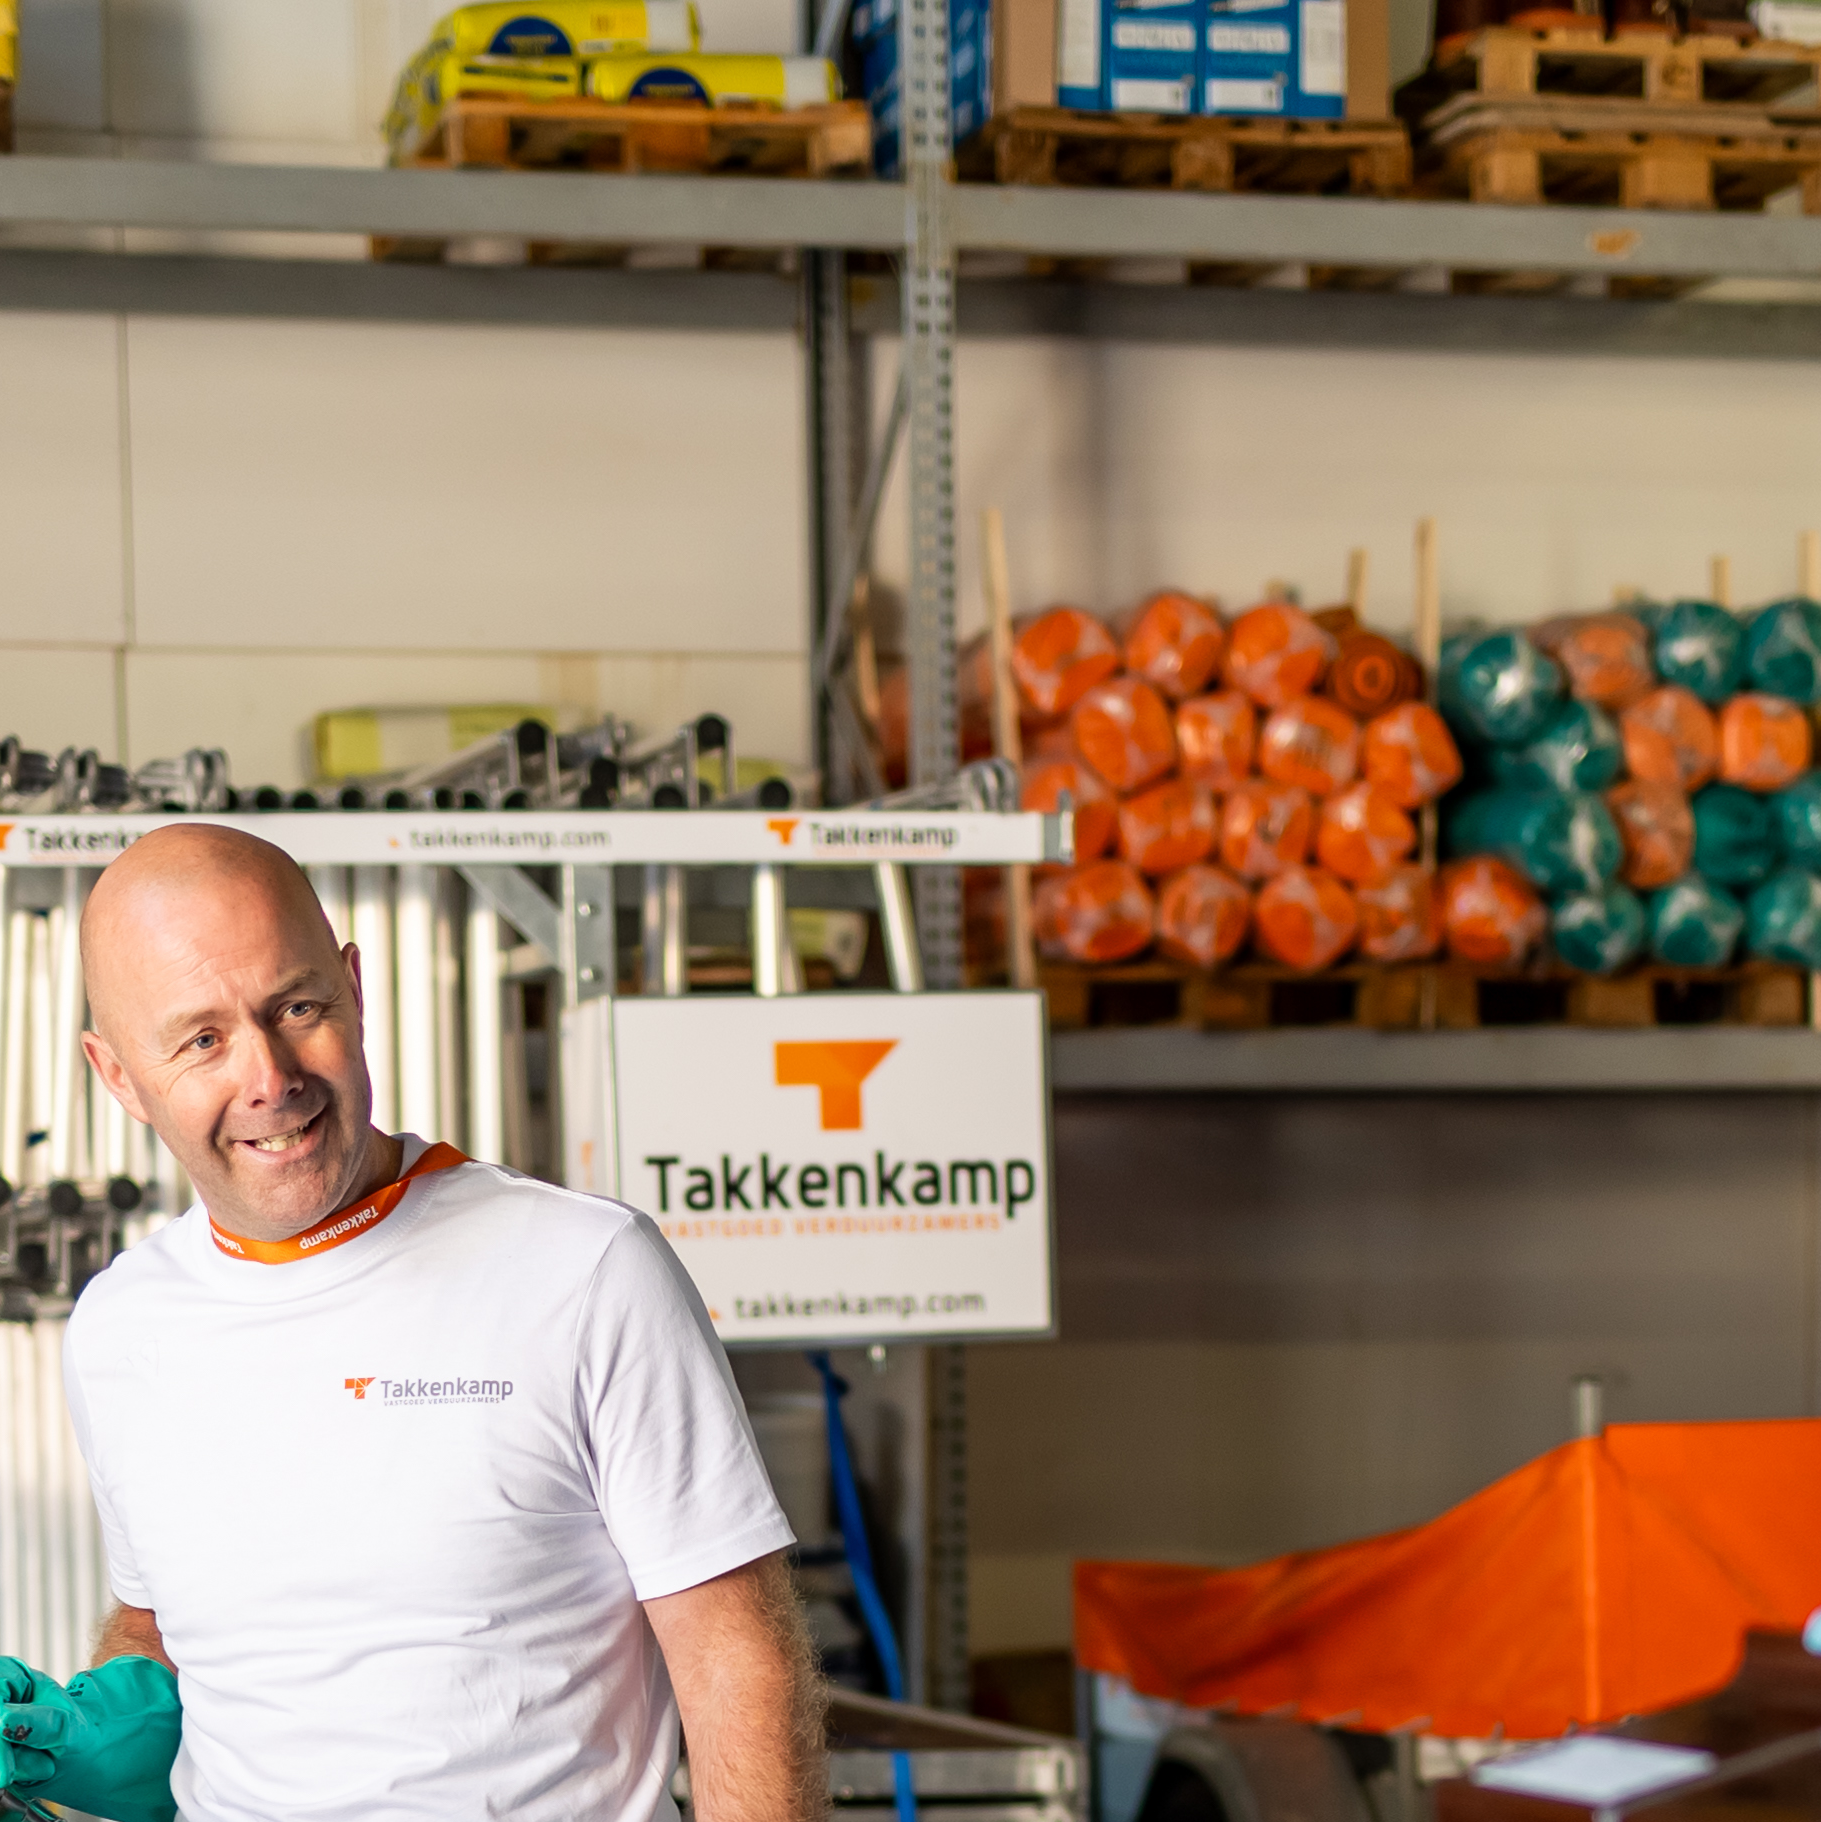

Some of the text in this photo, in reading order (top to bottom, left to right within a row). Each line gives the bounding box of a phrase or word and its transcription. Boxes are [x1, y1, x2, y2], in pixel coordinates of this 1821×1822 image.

[25, 826, 142, 852] Takkenk
[410, 828, 609, 851] takkenkamp.com
[810, 822, 957, 849] Takkenkamp
[645, 1152, 1036, 1219] Takkenkamp
[299, 1205, 379, 1250] Takkenkamp
[795, 1213, 1000, 1234] VERDUURZAMERS
[735, 1292, 985, 1321] takkenkamp.com
[380, 1377, 514, 1401] Takkenkamp
[428, 1397, 500, 1405] VERDUURZAMERS
